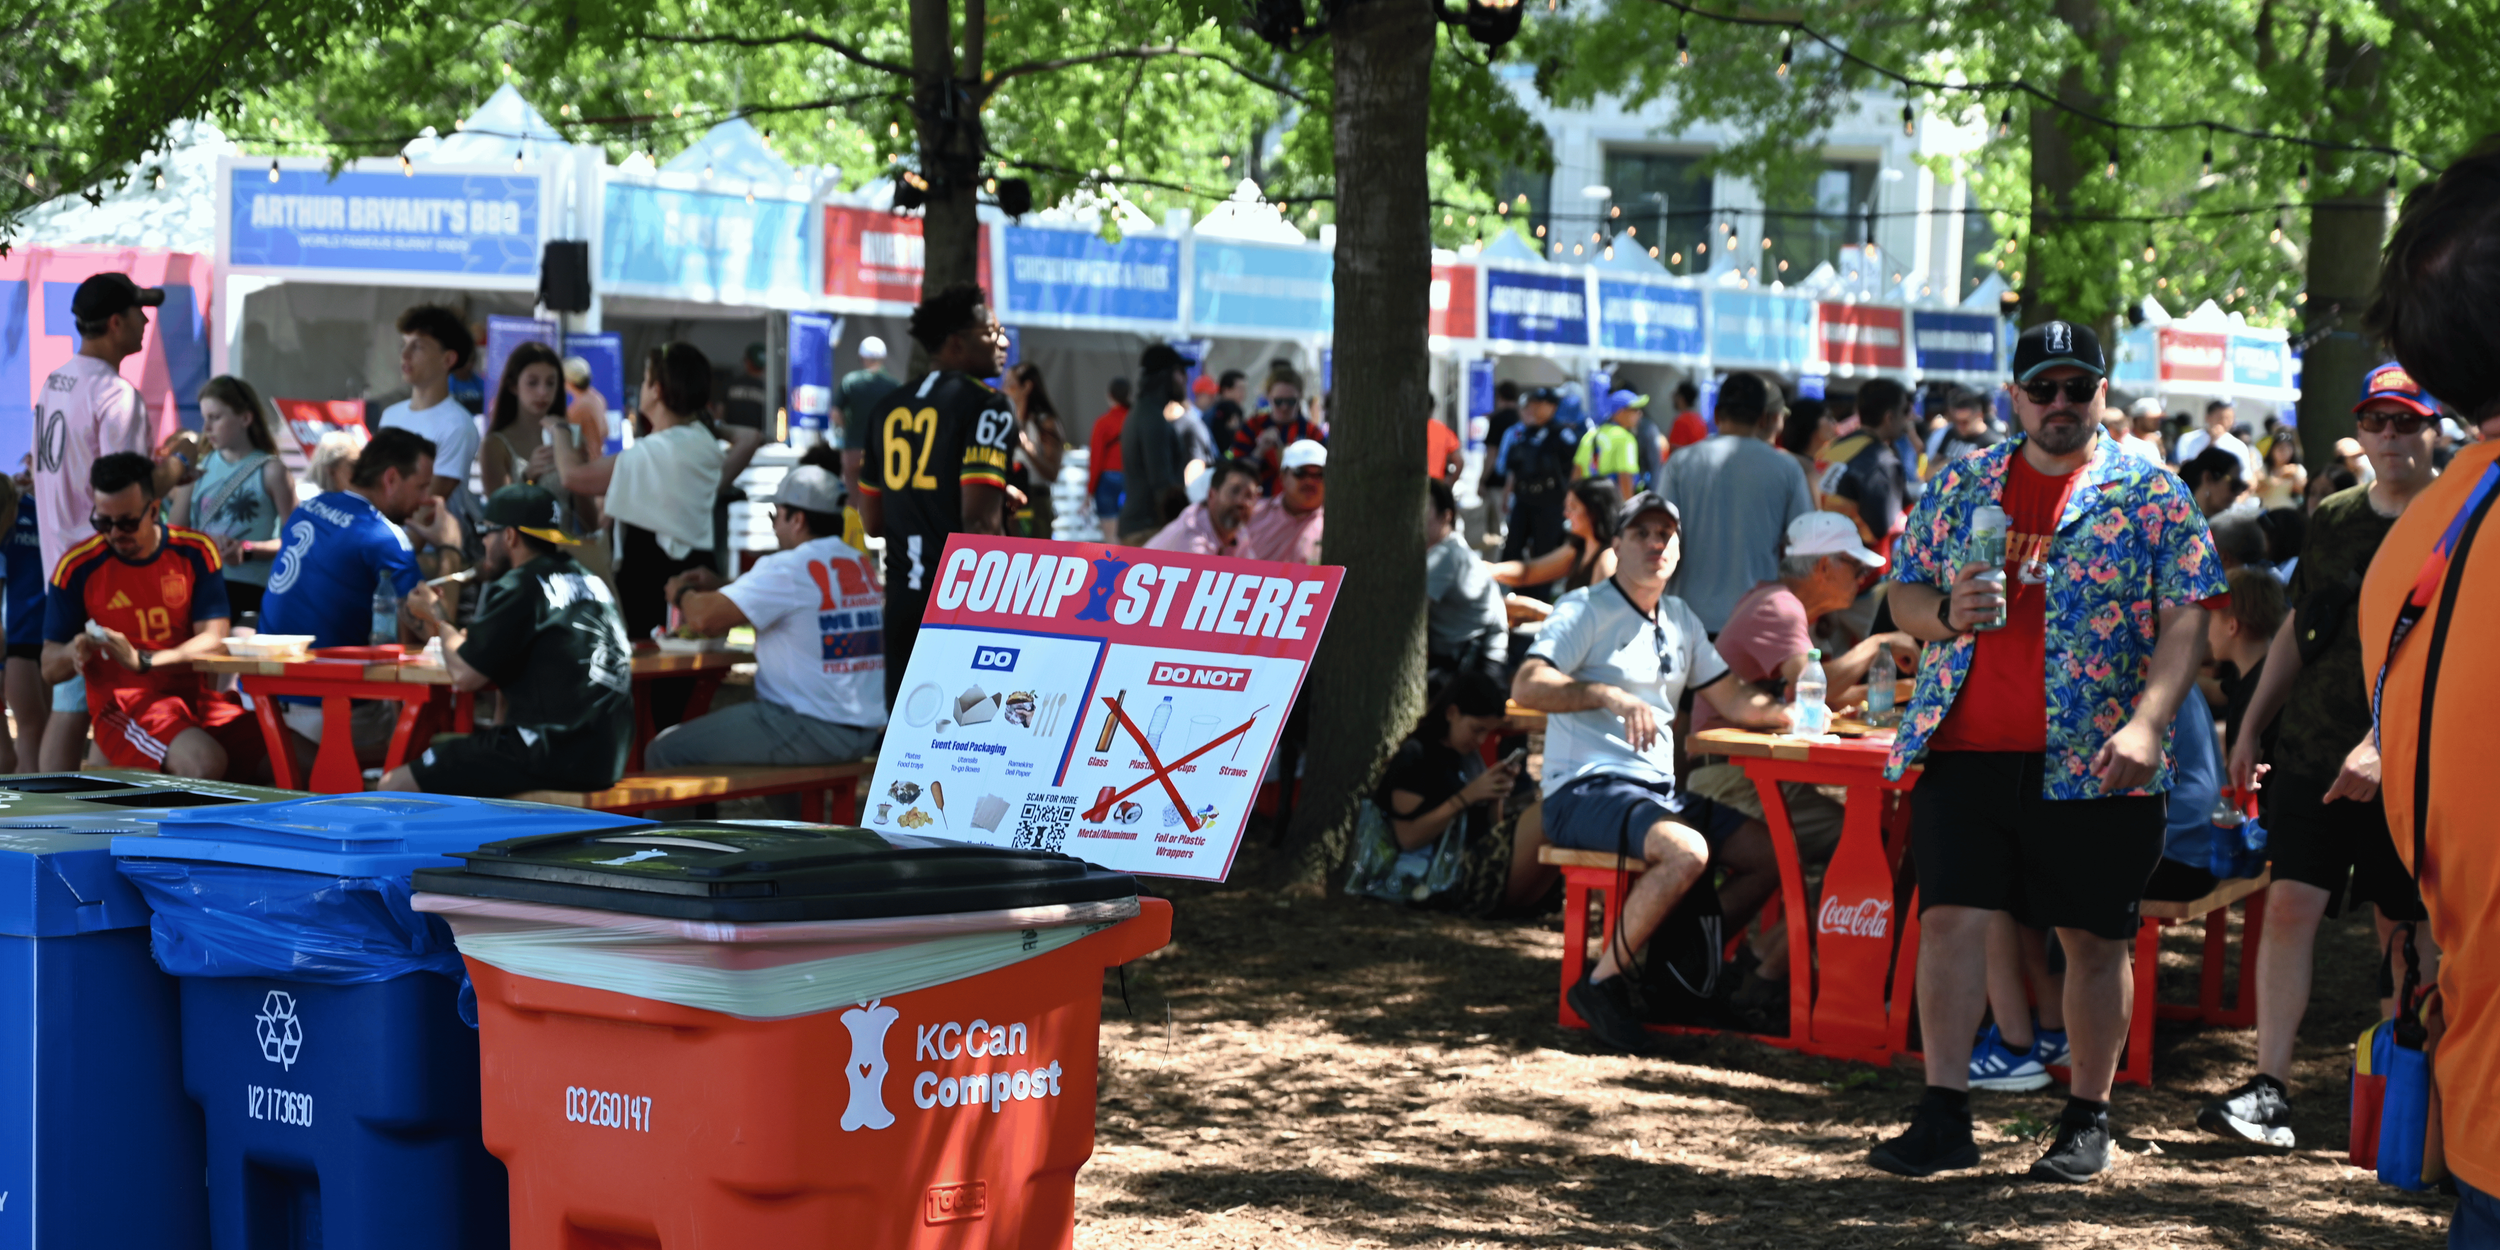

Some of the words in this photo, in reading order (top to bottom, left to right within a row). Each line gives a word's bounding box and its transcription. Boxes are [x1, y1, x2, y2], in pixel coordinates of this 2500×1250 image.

[252, 194, 345, 229] ARTHUR
[349, 197, 467, 233] BRYANT'S
[470, 202, 520, 234] BBQ
[975, 408, 1013, 449] 62
[883, 406, 938, 491] 62
[268, 520, 315, 594] 3
[1181, 571, 1324, 640] HERE
[135, 607, 171, 643] 19
[978, 650, 1012, 667] DO
[1155, 666, 1190, 683] DO
[1192, 669, 1244, 687] NOT
[931, 739, 951, 750] Event
[952, 741, 968, 751] Food
[969, 742, 1007, 755] Packaging
[905, 752, 921, 760] Plates
[957, 756, 978, 764] Utensils
[1088, 757, 1109, 767] Glass
[897, 760, 911, 769] Food
[911, 762, 924, 770] trays
[965, 766, 980, 774] Boxes
[1008, 760, 1034, 769] Ramekins
[1219, 765, 1248, 777] Straws
[1016, 770, 1031, 778] Paper
[1026, 792, 1045, 801] SCAN
[1045, 794, 1059, 803] FOR
[1060, 796, 1079, 804] MORE
[1077, 828, 1138, 841] Metal/Aluminum
[1154, 832, 1168, 843] Foil
[1169, 836, 1178, 844] or
[1178, 836, 1206, 846] Plastic
[1156, 846, 1194, 859] Wrappers
[1818, 895, 1892, 938] Coca-Cola
[916, 1021, 962, 1061] KC
[966, 1018, 1027, 1058] Can
[913, 1059, 1063, 1113] Compost
[566, 1085, 652, 1133] 03260147
